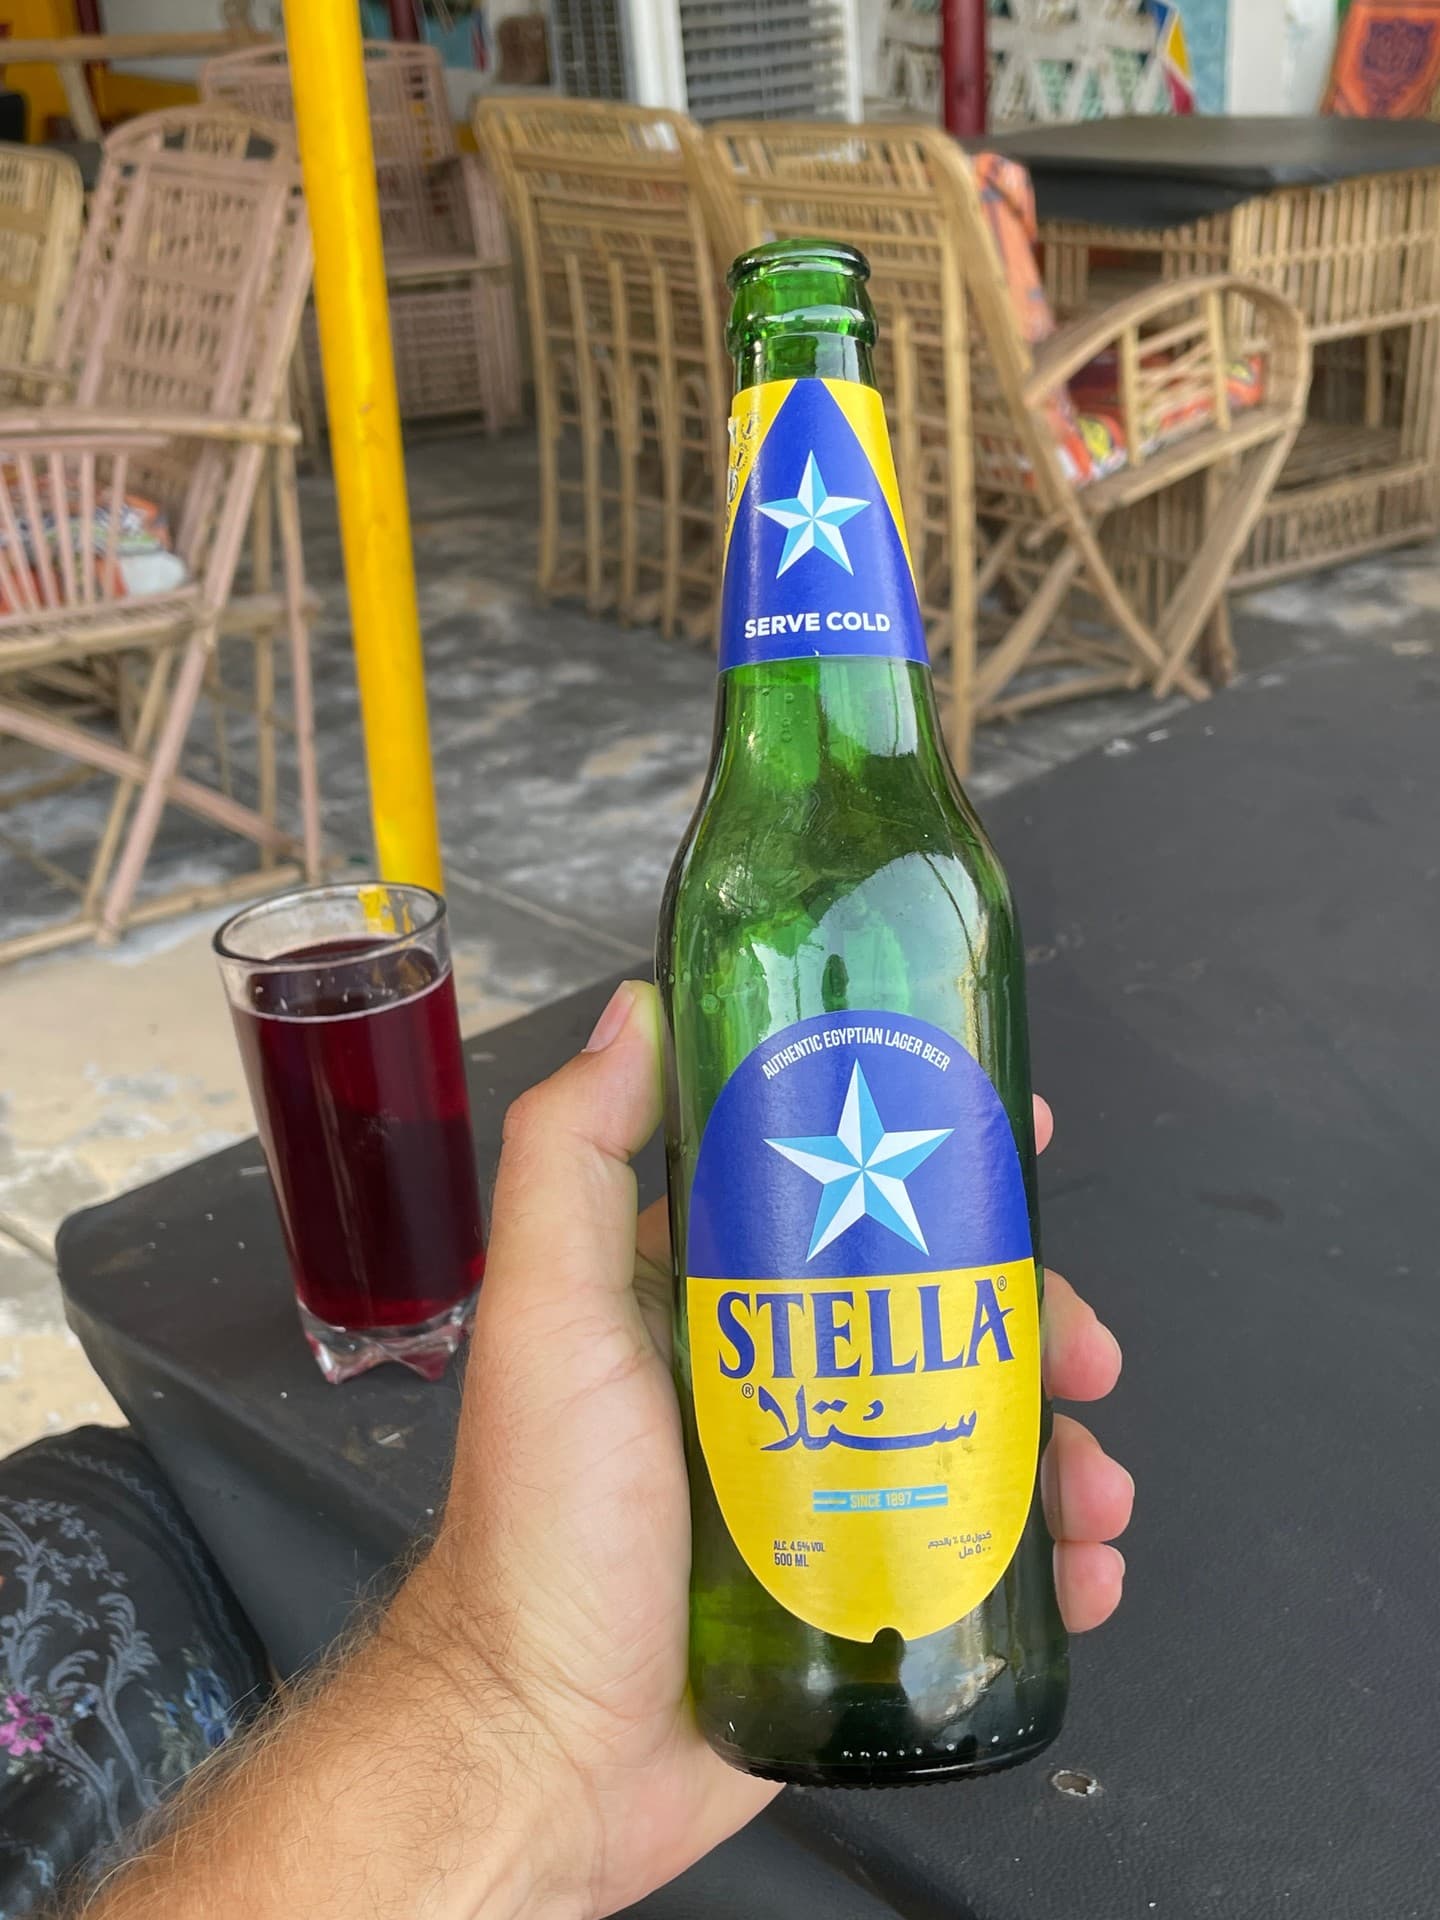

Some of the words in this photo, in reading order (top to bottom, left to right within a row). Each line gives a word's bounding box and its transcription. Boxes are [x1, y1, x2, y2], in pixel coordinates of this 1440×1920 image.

[744, 612, 821, 638] SERVE
[826, 611, 891, 632] COLD
[761, 1034, 823, 1080] AUTHENTIC
[824, 1027, 884, 1048] EGYPTIAN
[885, 1029, 922, 1055] LAGER
[922, 1043, 951, 1072] BEER
[850, 1493, 880, 1508] SINCE
[885, 1490, 912, 1506] 1897
[774, 1552, 793, 1566] 500
[795, 1553, 809, 1567] ML
